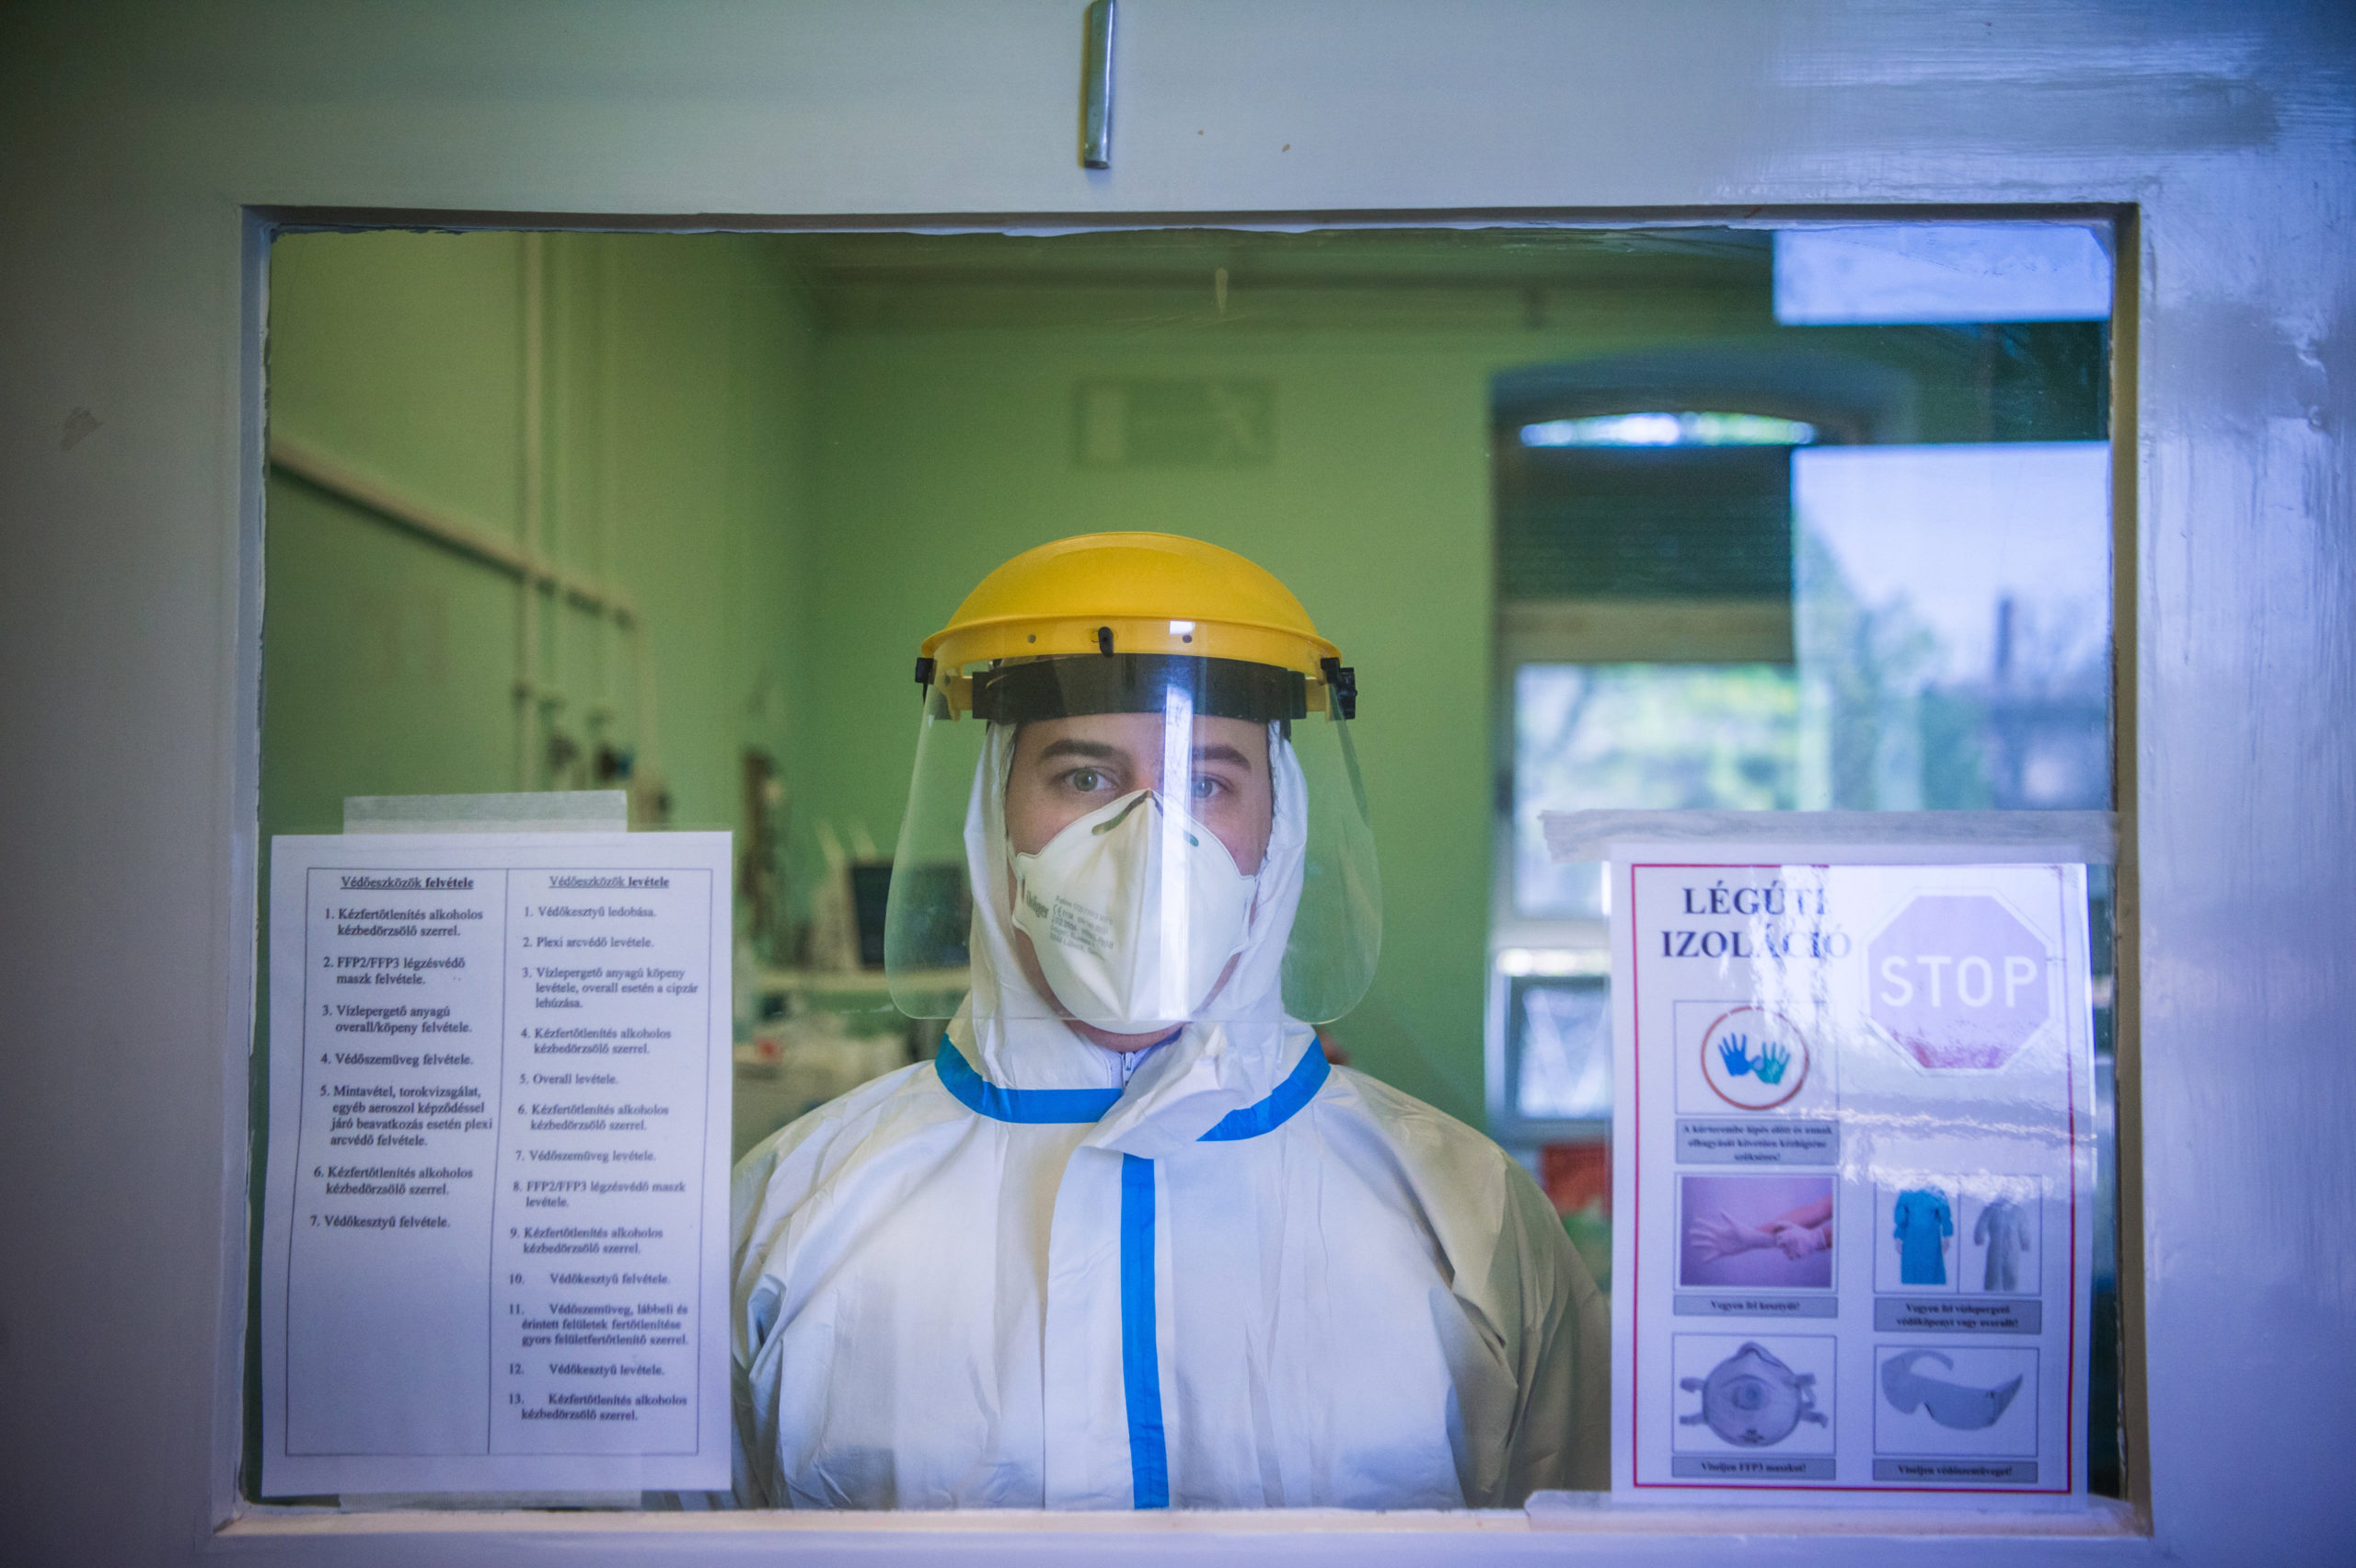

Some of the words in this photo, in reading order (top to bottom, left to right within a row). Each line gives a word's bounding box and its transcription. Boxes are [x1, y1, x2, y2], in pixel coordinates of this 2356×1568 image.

[341, 876, 422, 889] Védőeszközök
[425, 878, 474, 889] felvétele
[549, 876, 626, 888] Védőeszközök
[629, 876, 670, 888] levétele
[1682, 880, 1826, 915] LÉGÚTI
[325, 909, 335, 919] 1.
[338, 908, 426, 920] Kézfertőtlenítés
[429, 909, 483, 920] alkoholos
[525, 907, 533, 917] 1.
[538, 906, 606, 919] Védőkesztyű
[608, 907, 656, 917] ledobása.
[338, 925, 418, 937] kézbedörzsölő
[420, 926, 461, 937] szerrel.
[523, 938, 533, 947] 2.
[537, 937, 563, 947] Plexi
[566, 937, 607, 947] arcvédő
[610, 937, 653, 947] levétele.
[1660, 923, 1852, 958] IZOLÁCIÓ
[323, 957, 333, 968] 2.
[337, 956, 399, 969] FFP2/FFP3
[404, 957, 466, 971] légzésvédő
[337, 974, 371, 984] maszk
[375, 974, 426, 985] felvétele.
[522, 969, 532, 977] 3.
[537, 967, 603, 980] Vízlepergető
[606, 969, 644, 980] anyagú
[646, 968, 685, 980] köpeny
[1879, 954, 2038, 1009] STOP
[536, 983, 579, 994] levétele,
[582, 983, 618, 993] overall
[621, 983, 654, 993] esetén
[665, 983, 699, 996] cipzár
[536, 997, 583, 1009] lehúzása.
[322, 1005, 332, 1016] 3.
[336, 1005, 407, 1018] Vízlepergető
[410, 1006, 451, 1019] anyagú
[335, 1021, 418, 1035] overall/köpeny
[422, 1021, 472, 1032] felvétele.
[521, 1029, 530, 1038] 4.
[535, 1028, 618, 1039] Kézfertőtlenítés
[620, 1029, 671, 1039] alkoholos
[534, 1043, 609, 1054] kézbedörzsölő
[612, 1044, 650, 1054] szerrel.
[320, 1054, 330, 1064] 4.
[335, 1053, 420, 1067] Védőszemüveg
[422, 1054, 473, 1065] felvétele.
[520, 1075, 529, 1084] 5.
[533, 1074, 572, 1084] Overall
[575, 1074, 618, 1084] levétele.
[319, 1086, 330, 1096] 5.
[333, 1085, 396, 1098] Mintavétel,
[399, 1086, 481, 1099] torokvizsgálat,
[332, 1101, 365, 1115] egyéb
[368, 1102, 415, 1113] aeroszol
[418, 1101, 485, 1116] képződéssel
[518, 1105, 527, 1114] 6.
[532, 1104, 615, 1115] Kézfertőtlenítés
[618, 1105, 669, 1115] alkoholos
[329, 1118, 353, 1132] járó
[356, 1118, 423, 1129] beavatkozás
[426, 1118, 462, 1129] esetén
[465, 1118, 492, 1132] plexi
[530, 1120, 606, 1131] kézbedörzsölő
[609, 1120, 646, 1131] szerrel.
[330, 1135, 375, 1146] arcvédő
[377, 1135, 428, 1146] felvétele.
[515, 1152, 525, 1160] 7.
[529, 1150, 609, 1163] Védőszemüveg
[612, 1150, 656, 1161] levétele.
[314, 1167, 324, 1178] 6.
[328, 1166, 415, 1179] Kézfertőtlenítés
[419, 1167, 473, 1179] alkoholos
[326, 1182, 406, 1194] kézbedörzsölő
[410, 1183, 448, 1195] szerrel.
[526, 1181, 587, 1193] FFP2/FFP3
[590, 1182, 650, 1193] légzésvédő
[652, 1182, 686, 1193] maszk
[526, 1196, 569, 1207] levétele.
[310, 1216, 320, 1227] 7.
[325, 1215, 396, 1230] Védőkesztyű
[399, 1216, 451, 1228] felvétele.
[510, 1228, 520, 1238] 9.
[611, 1228, 663, 1238] alkoholos
[603, 1243, 641, 1254] szerrel.
[510, 1274, 525, 1285] 10.
[622, 1274, 670, 1285] felvétele.
[510, 1304, 525, 1314] 11.
[562, 1320, 607, 1330] felületek
[522, 1335, 551, 1347] gyors
[650, 1335, 687, 1345] szerrel.
[510, 1364, 524, 1375] 12.
[620, 1364, 664, 1376] levétele.
[510, 1394, 524, 1404] 13.
[635, 1394, 687, 1405] alkoholos
[599, 1410, 638, 1421] szerrel.
